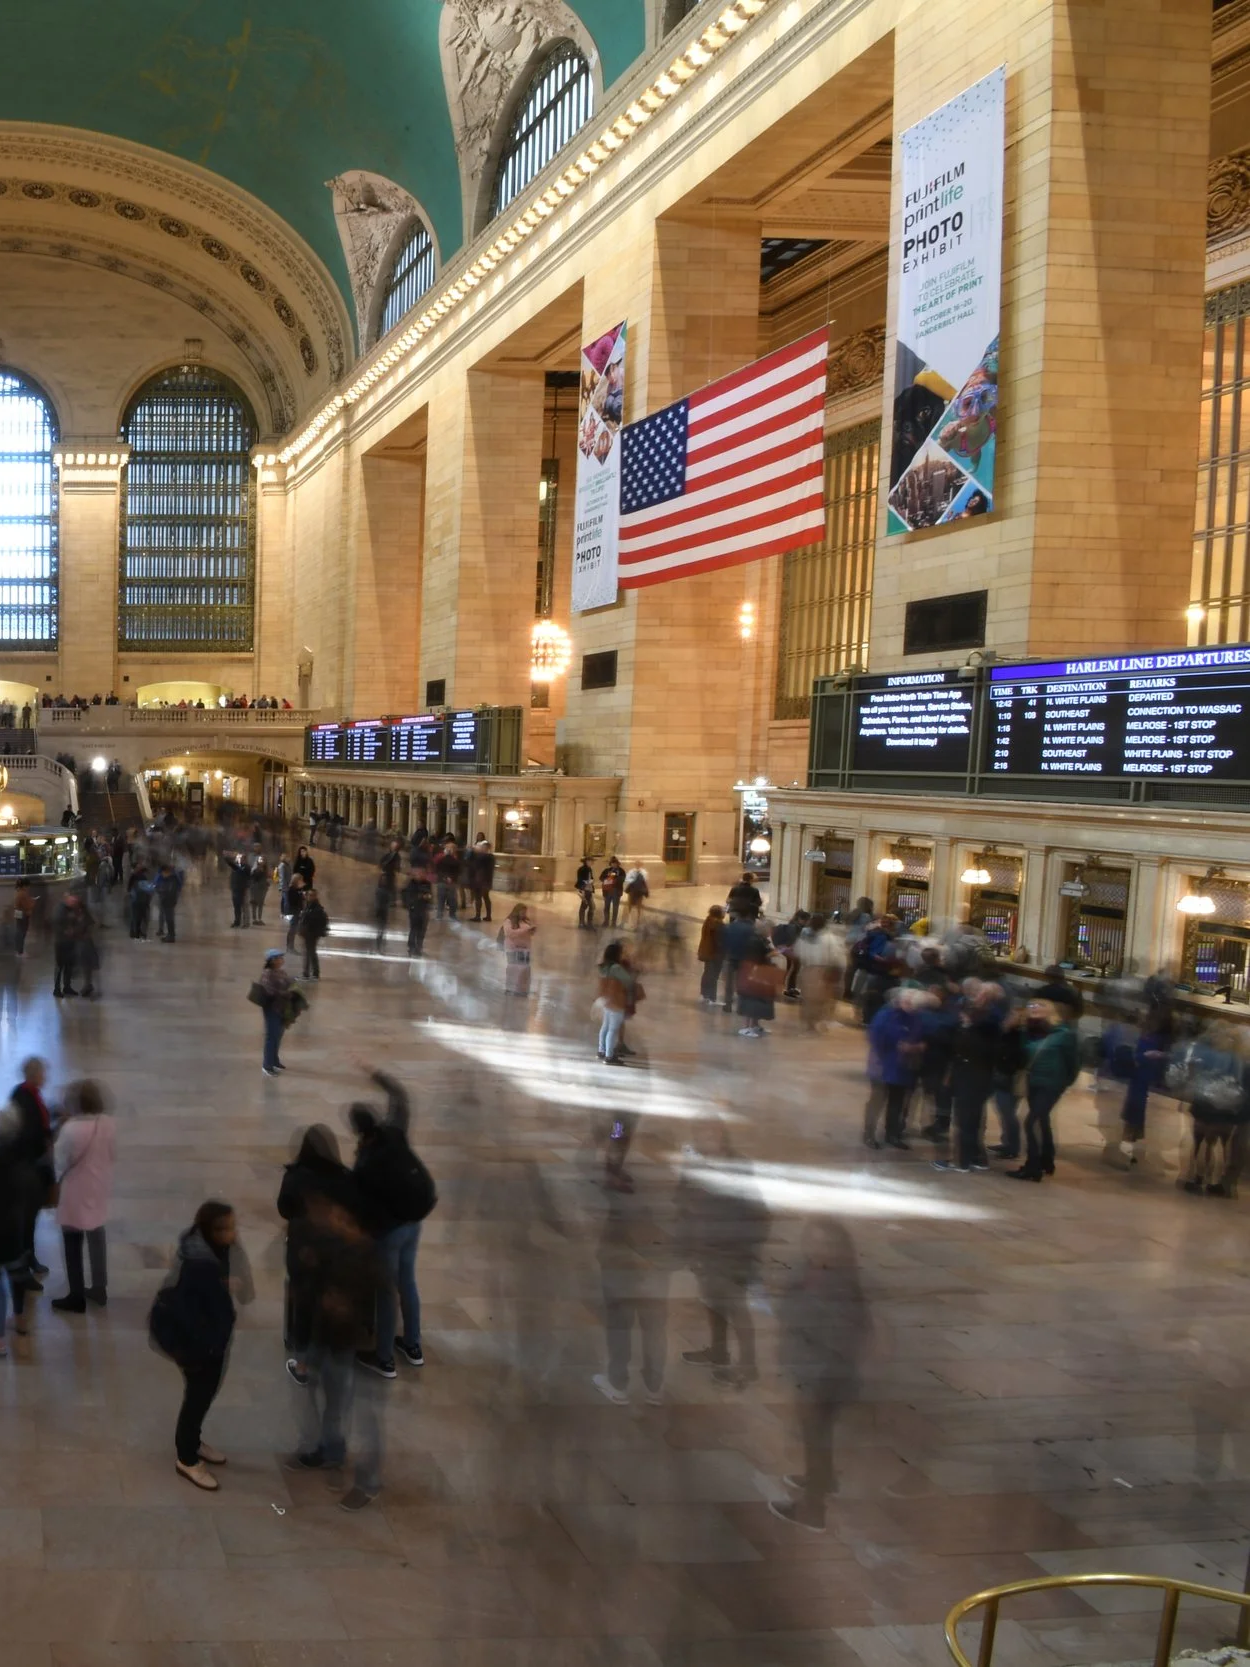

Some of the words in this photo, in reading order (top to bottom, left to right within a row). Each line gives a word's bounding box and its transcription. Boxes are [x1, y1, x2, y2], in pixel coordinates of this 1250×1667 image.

[905, 161, 965, 208] FUJIFILM
[904, 184, 964, 235] printlife
[904, 212, 963, 258] PHOTO
[903, 233, 962, 274] EXHIBIT
[920, 277, 937, 292] JOIN
[939, 256, 974, 281] FUJIFILM
[919, 292, 928, 302] TO
[930, 268, 976, 297] CELEBRATE
[913, 304, 927, 316] THE
[929, 295, 944, 308] ART
[946, 290, 956, 300] OF
[958, 275, 984, 294] PRINT
[916, 316, 955, 340] VANDERBILT
[958, 308, 975, 320] HALL
[919, 308, 952, 327] OCTOBER
[576, 546, 601, 564] PHOTO
[1066, 660, 1118, 674] HARLEM
[1121, 657, 1153, 670] LINE
[1156, 650, 1250, 668] DEPARTURES
[888, 674, 944, 686] INFORMATION
[993, 687, 1013, 696] TIME
[1021, 686, 1038, 694] TRK
[1046, 682, 1106, 694] DESTINATION
[1130, 678, 1176, 688] REMARKS
[948, 690, 962, 700] App
[996, 700, 1012, 708] 12:42
[1080, 696, 1108, 704] PLAINS
[1128, 692, 1174, 702] DEPARTED
[1045, 710, 1090, 718] SOUTHEAST
[1128, 706, 1183, 716] CONNECTION
[1185, 706, 1198, 714] TO
[1199, 704, 1242, 714] WASSAIC
[1078, 723, 1105, 731] PLAINS
[1126, 721, 1167, 730] MELROSE
[1174, 721, 1190, 729] 1ST
[1191, 720, 1216, 728] STOP
[1076, 736, 1104, 744] PLAINS
[1126, 736, 1166, 744] MELROSE
[1190, 736, 1215, 744] STOP
[1042, 750, 1087, 758] SOUTHEAST
[1124, 750, 1151, 758] WHITE
[1152, 750, 1182, 758] PLAINS
[1190, 750, 1206, 758] 1ST
[1207, 750, 1233, 758] STOP
[1074, 763, 1102, 771] PLAINS
[1123, 764, 1164, 772] MELROSE
[1170, 764, 1186, 772] 1ST
[1187, 765, 1212, 773] STOP
